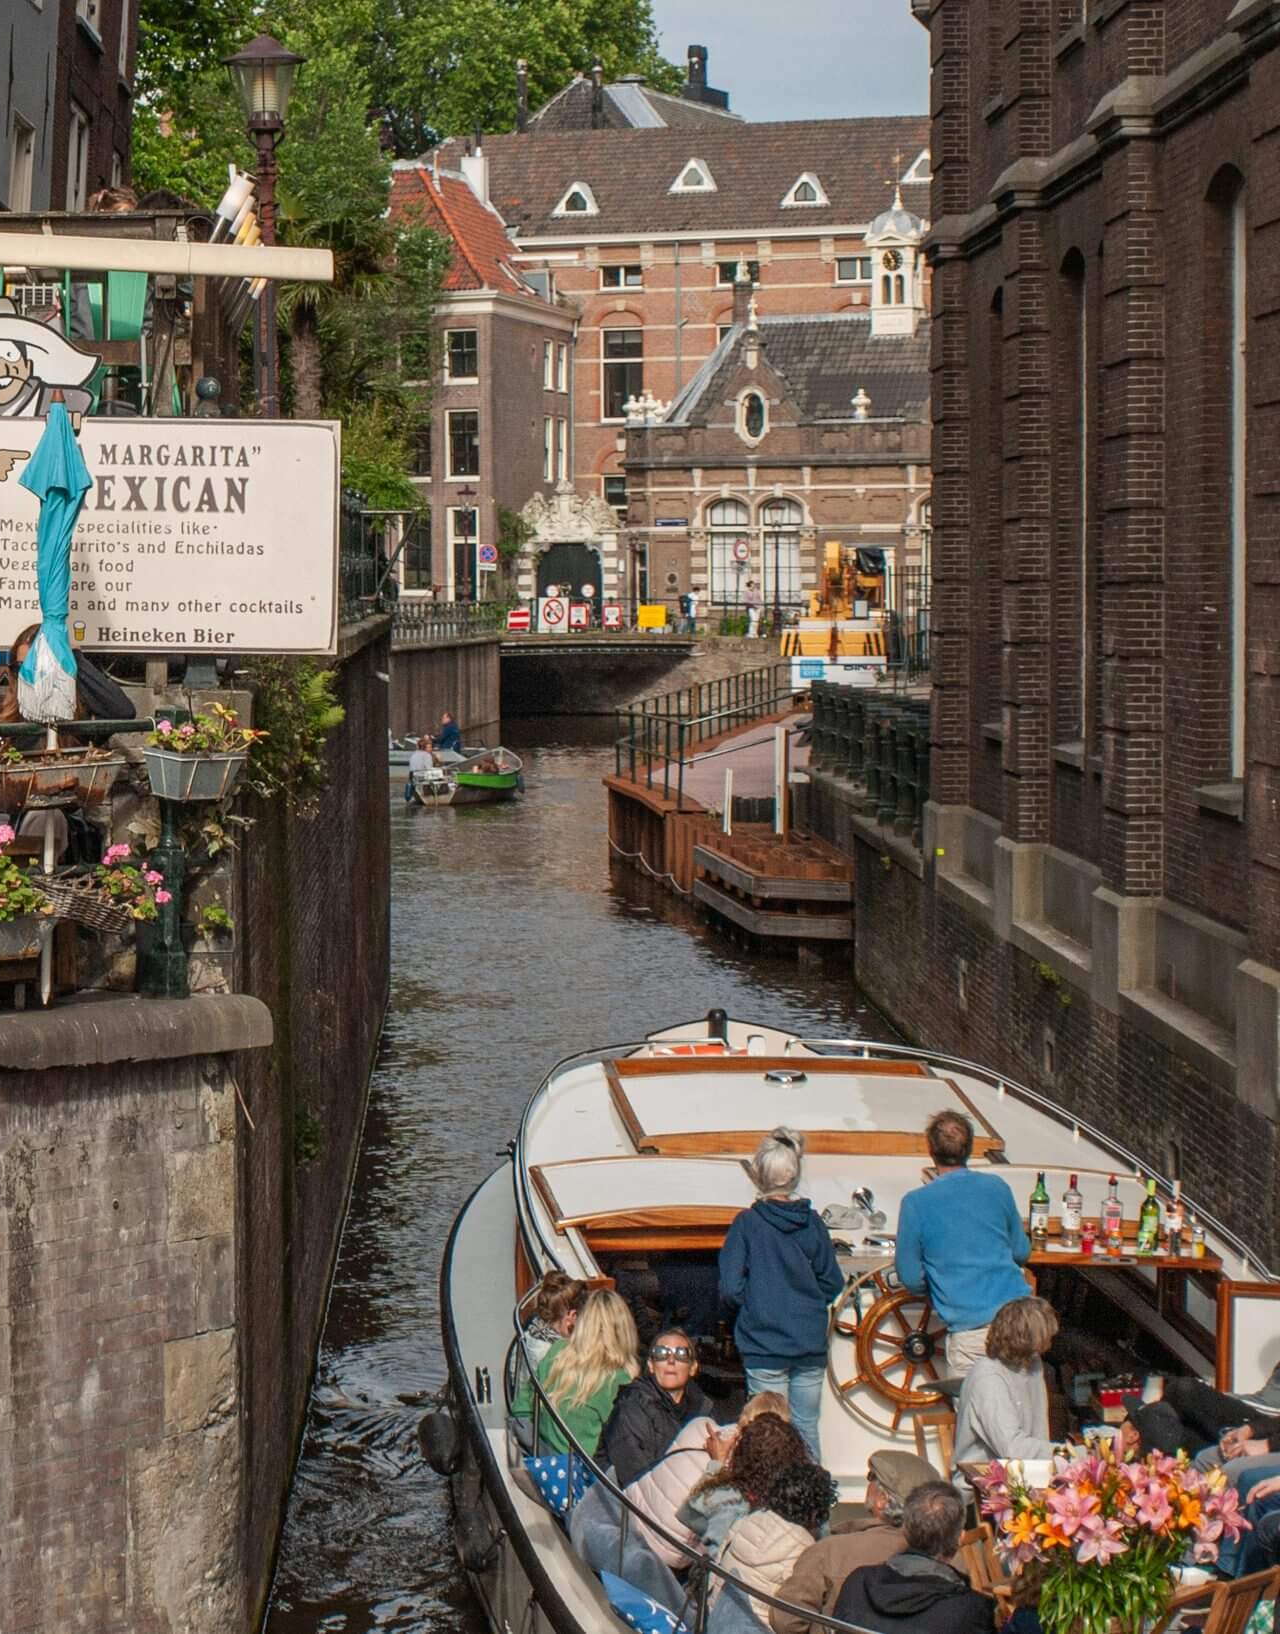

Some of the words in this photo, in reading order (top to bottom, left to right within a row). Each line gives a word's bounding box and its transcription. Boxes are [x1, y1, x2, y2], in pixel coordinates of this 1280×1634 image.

[82, 476, 248, 514] EXICAN
[77, 520, 172, 535] specialities
[0, 538, 39, 552] Taco
[71, 540, 129, 553] urrito's
[138, 541, 166, 553] and
[175, 541, 265, 555] Enchiladas
[99, 559, 134, 573] food
[72, 580, 96, 592] are
[105, 581, 133, 592] our
[87, 598, 116, 611] and
[126, 600, 169, 613] many
[178, 600, 221, 613] other
[229, 600, 304, 614] cocktails
[97, 627, 187, 643] Heineken
[193, 628, 236, 644] Bier
